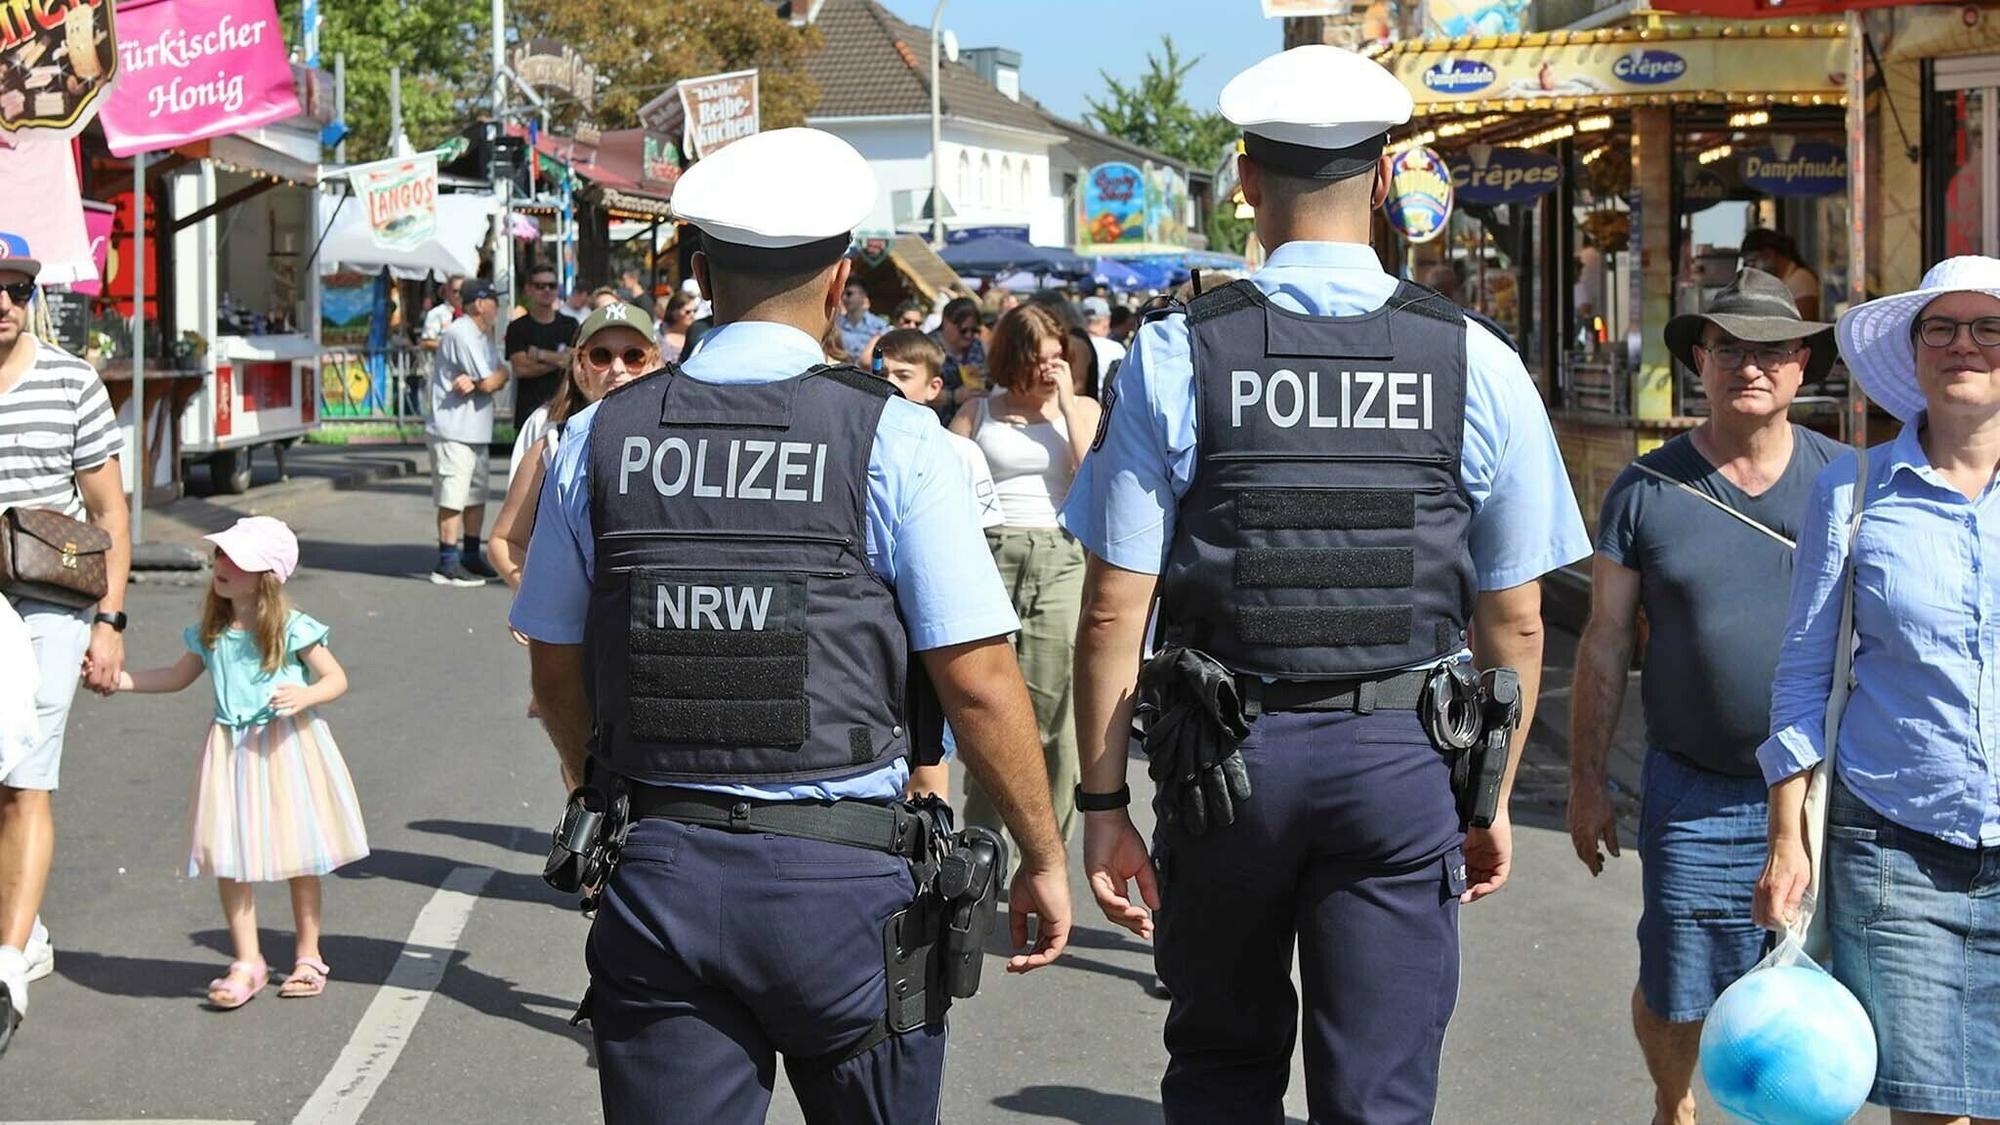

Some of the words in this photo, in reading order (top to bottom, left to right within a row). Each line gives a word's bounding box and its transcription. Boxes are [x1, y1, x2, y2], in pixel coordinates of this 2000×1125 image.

[1614, 57, 1684, 78] Crêpes
[148, 70, 244, 117] Honig
[1451, 163, 1559, 191] Crêpes
[368, 175, 433, 229] LANGOS
[1231, 369, 1433, 430] POLIZEI
[619, 436, 828, 502] POLIZEI
[656, 584, 773, 631] NRW
